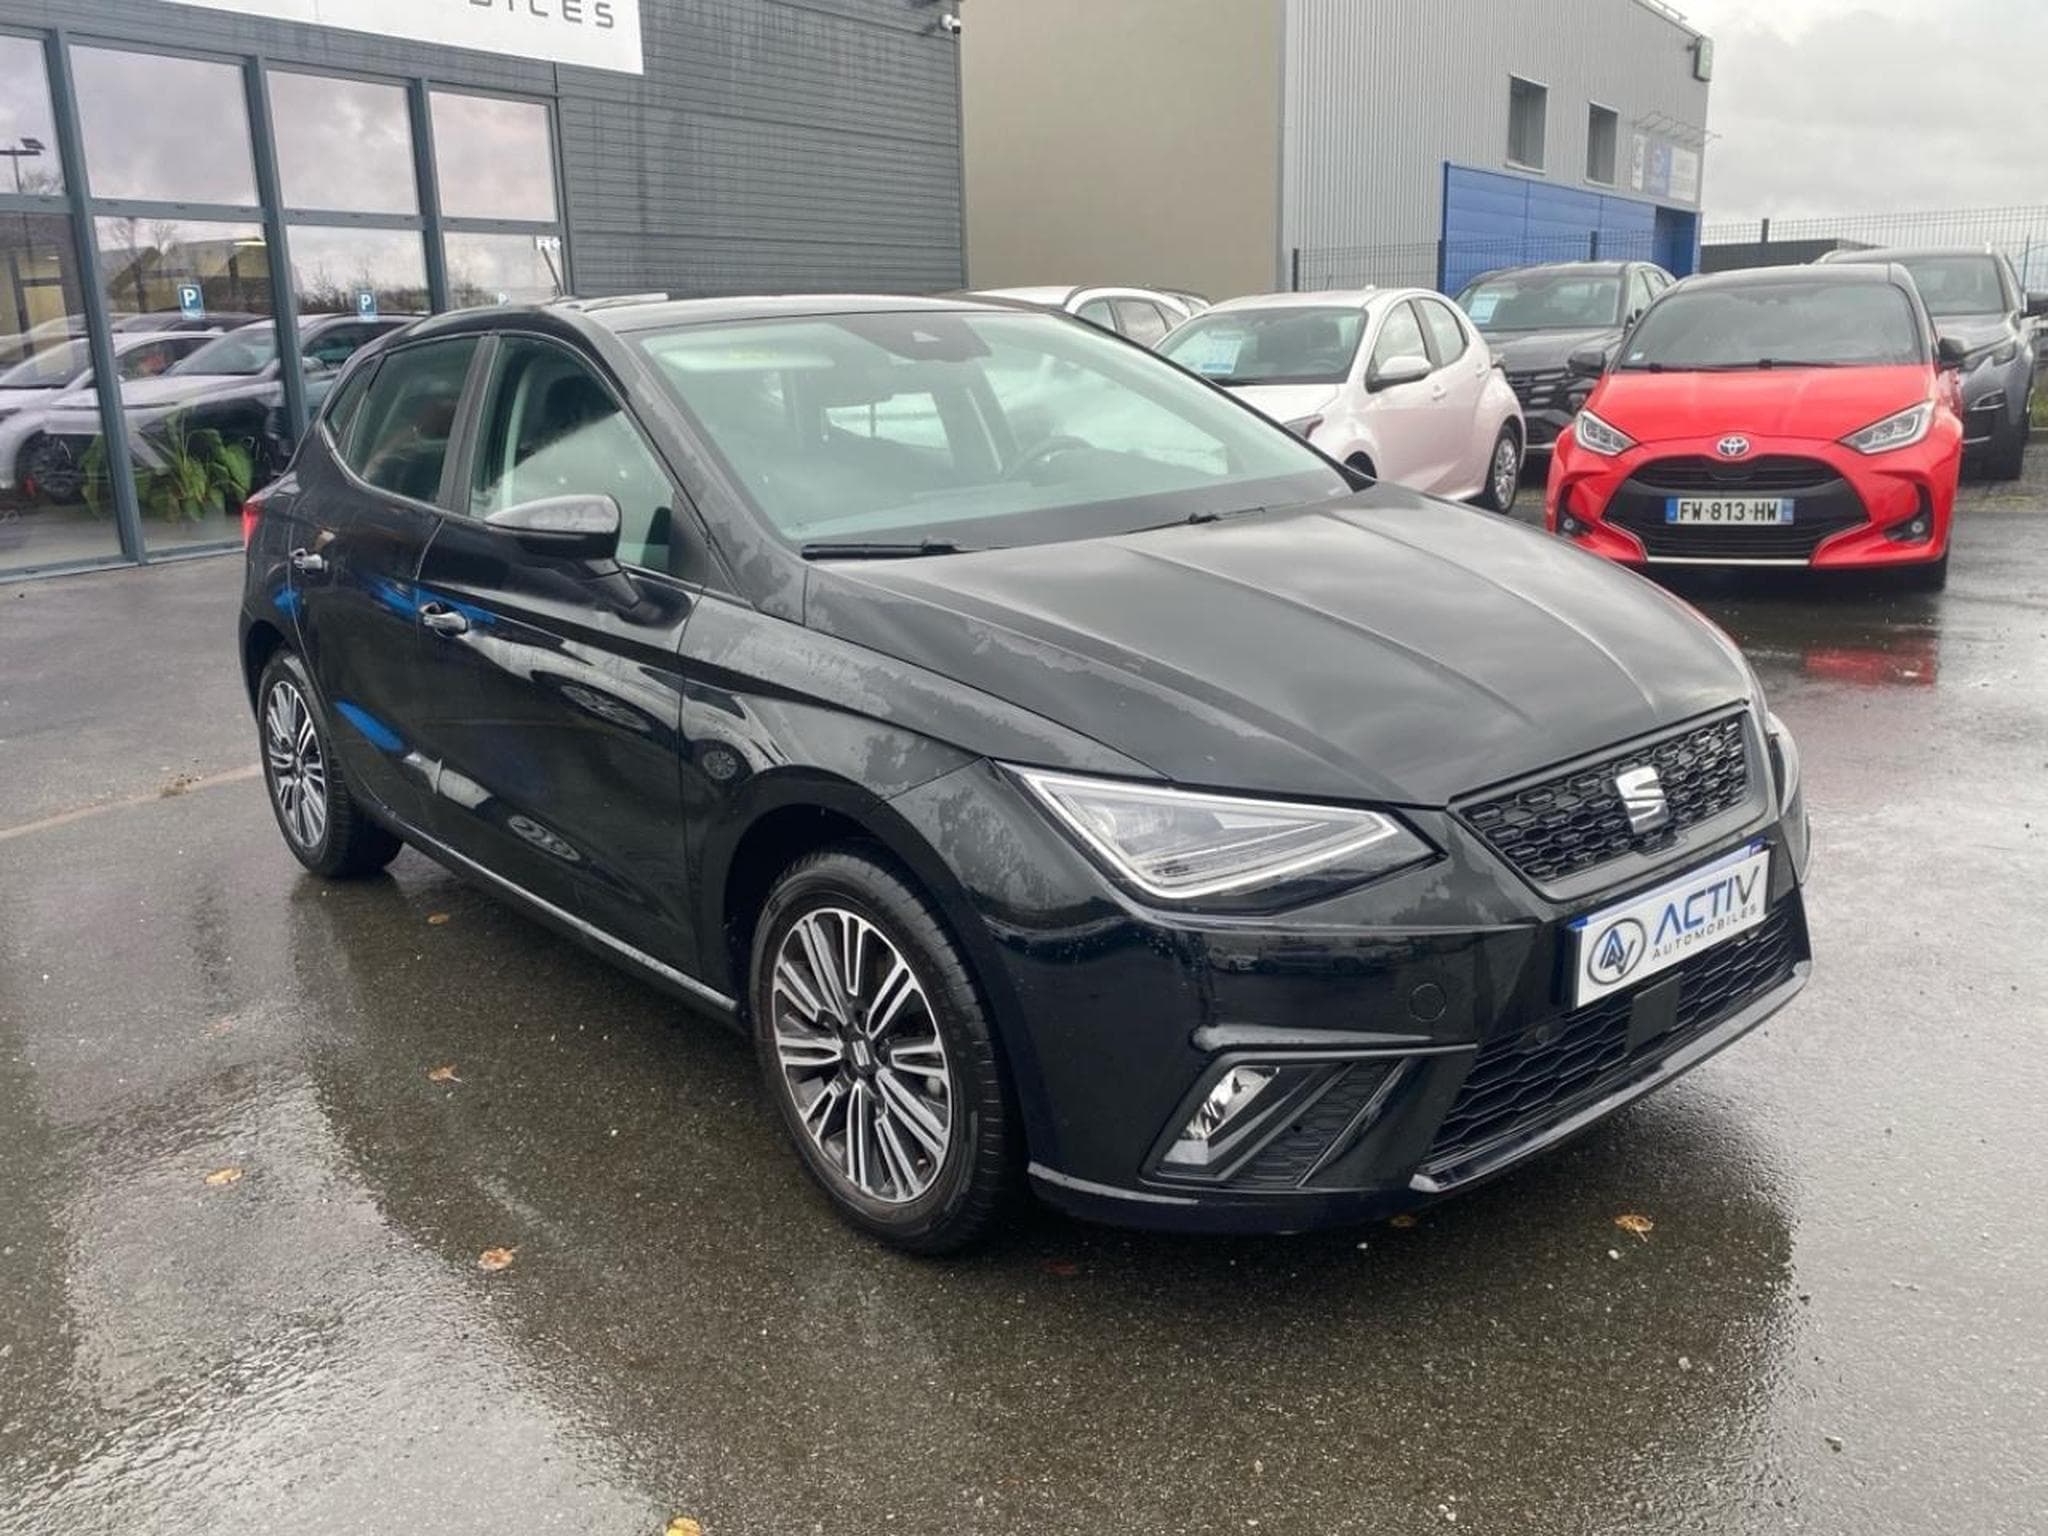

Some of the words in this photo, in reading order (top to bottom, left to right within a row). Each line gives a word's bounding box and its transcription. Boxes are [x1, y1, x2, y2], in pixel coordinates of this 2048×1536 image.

[469, 0, 614, 29] LES
[1651, 903, 1757, 960] AUTOMOBILES
[1653, 866, 1760, 945] ACTIV
